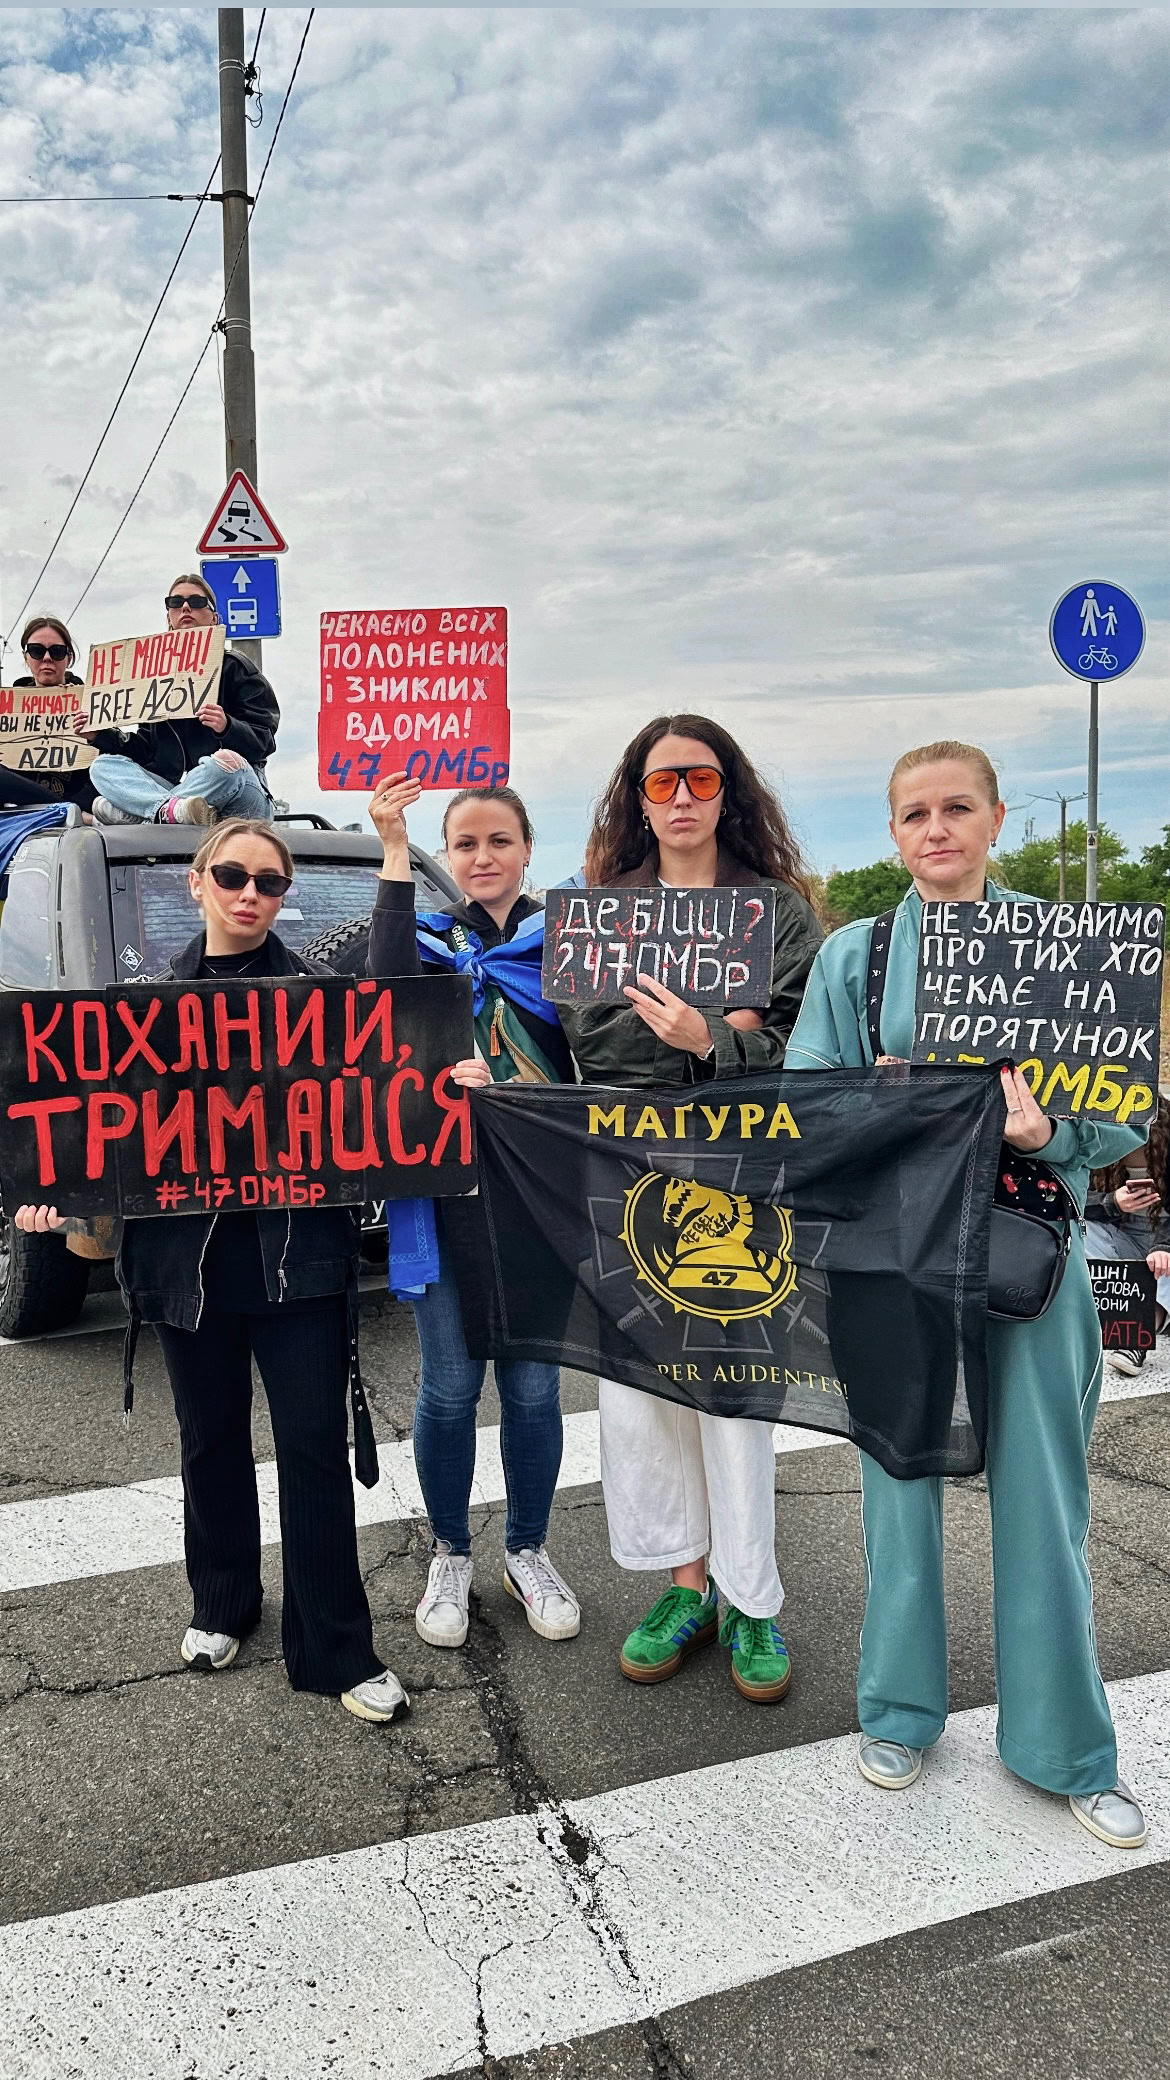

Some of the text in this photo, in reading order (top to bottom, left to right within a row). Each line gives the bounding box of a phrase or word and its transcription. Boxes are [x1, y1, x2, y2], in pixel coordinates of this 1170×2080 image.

[320, 613, 427, 638] ЧЕКАЄМО
[92, 628, 213, 686] НЕ МОВЧИ!
[322, 641, 507, 669] ПОЛОНЕНИХ
[21, 694, 80, 714] КРИЧАТЬ
[89, 688, 134, 725] FREE
[345, 676, 489, 703] ЗНИКЛИХ
[24, 715, 41, 732] НЕ
[346, 706, 472, 748] ВДОМА!
[18, 745, 79, 768] AZOV
[328, 751, 382, 788] 47
[452, 925, 470, 952] GERM
[922, 902, 1163, 939] НЕ ЗАБУВАЙМО
[922, 936, 1162, 976] ПРО ТИХ ХТО
[923, 971, 1116, 1014] ЧЕКАЄ НА
[21, 981, 413, 1083] КОХАНИЙ,
[919, 1013, 1155, 1061] ПОРЯТУНОК
[8, 1066, 472, 1187] ТРИМАЙСЯ
[702, 1271, 738, 1286] 47
[1093, 1281, 1145, 1301] СЛОВА,
[713, 1364, 849, 1400] AUDENTES!
